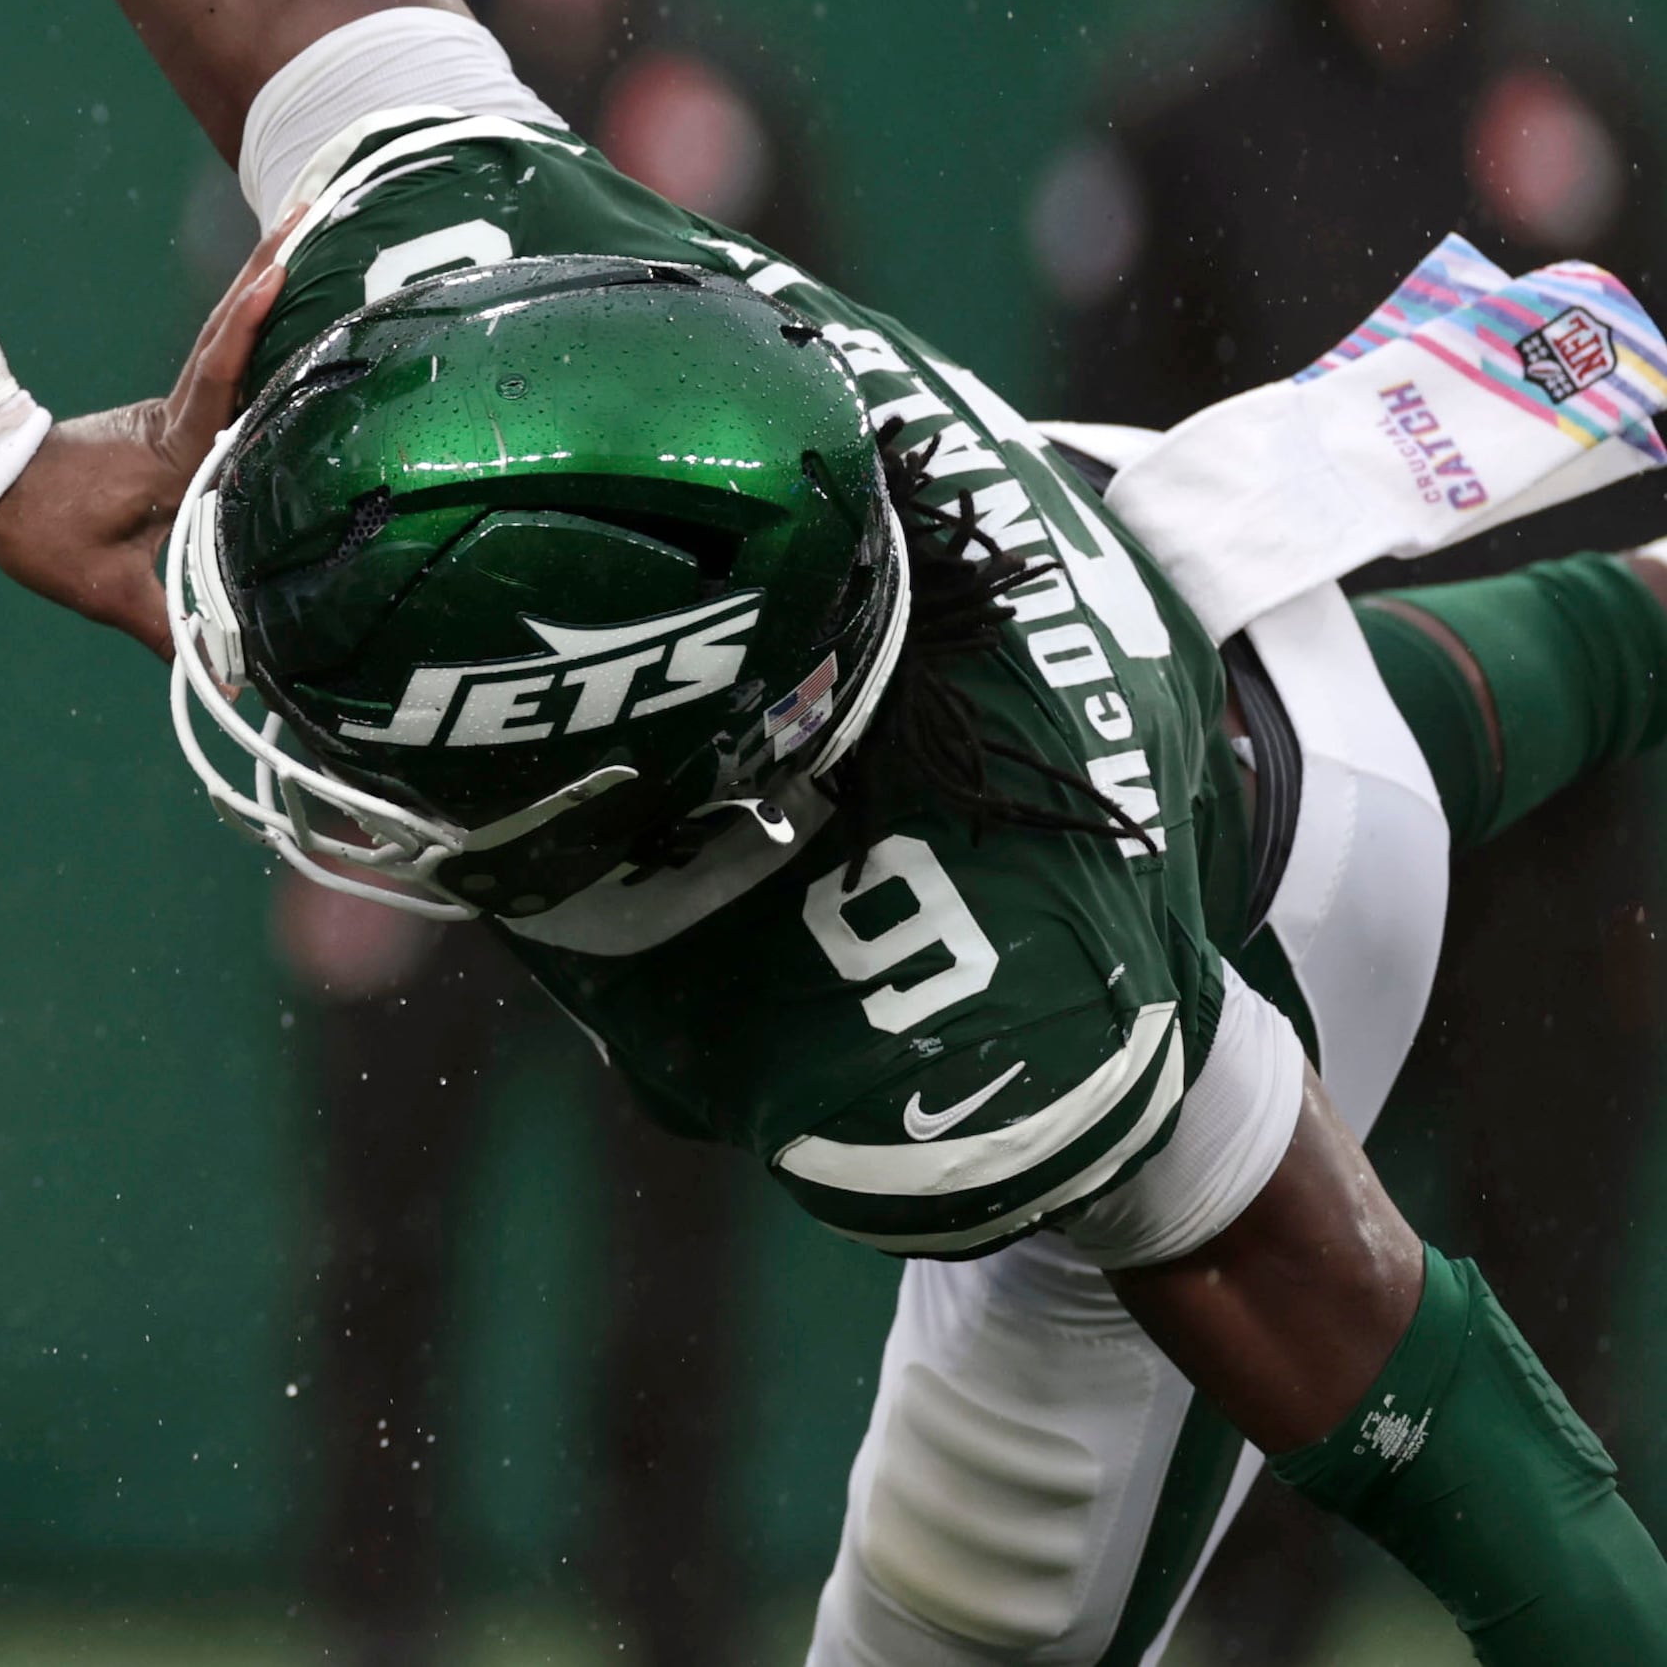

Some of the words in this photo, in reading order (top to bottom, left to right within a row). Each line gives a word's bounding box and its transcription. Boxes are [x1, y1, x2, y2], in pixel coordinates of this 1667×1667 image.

[1375, 413, 1443, 505] CRUCIAL
[1378, 380, 1489, 512] CATCH
[337, 596, 765, 748] JETS
[801, 834, 1000, 1034] 9
